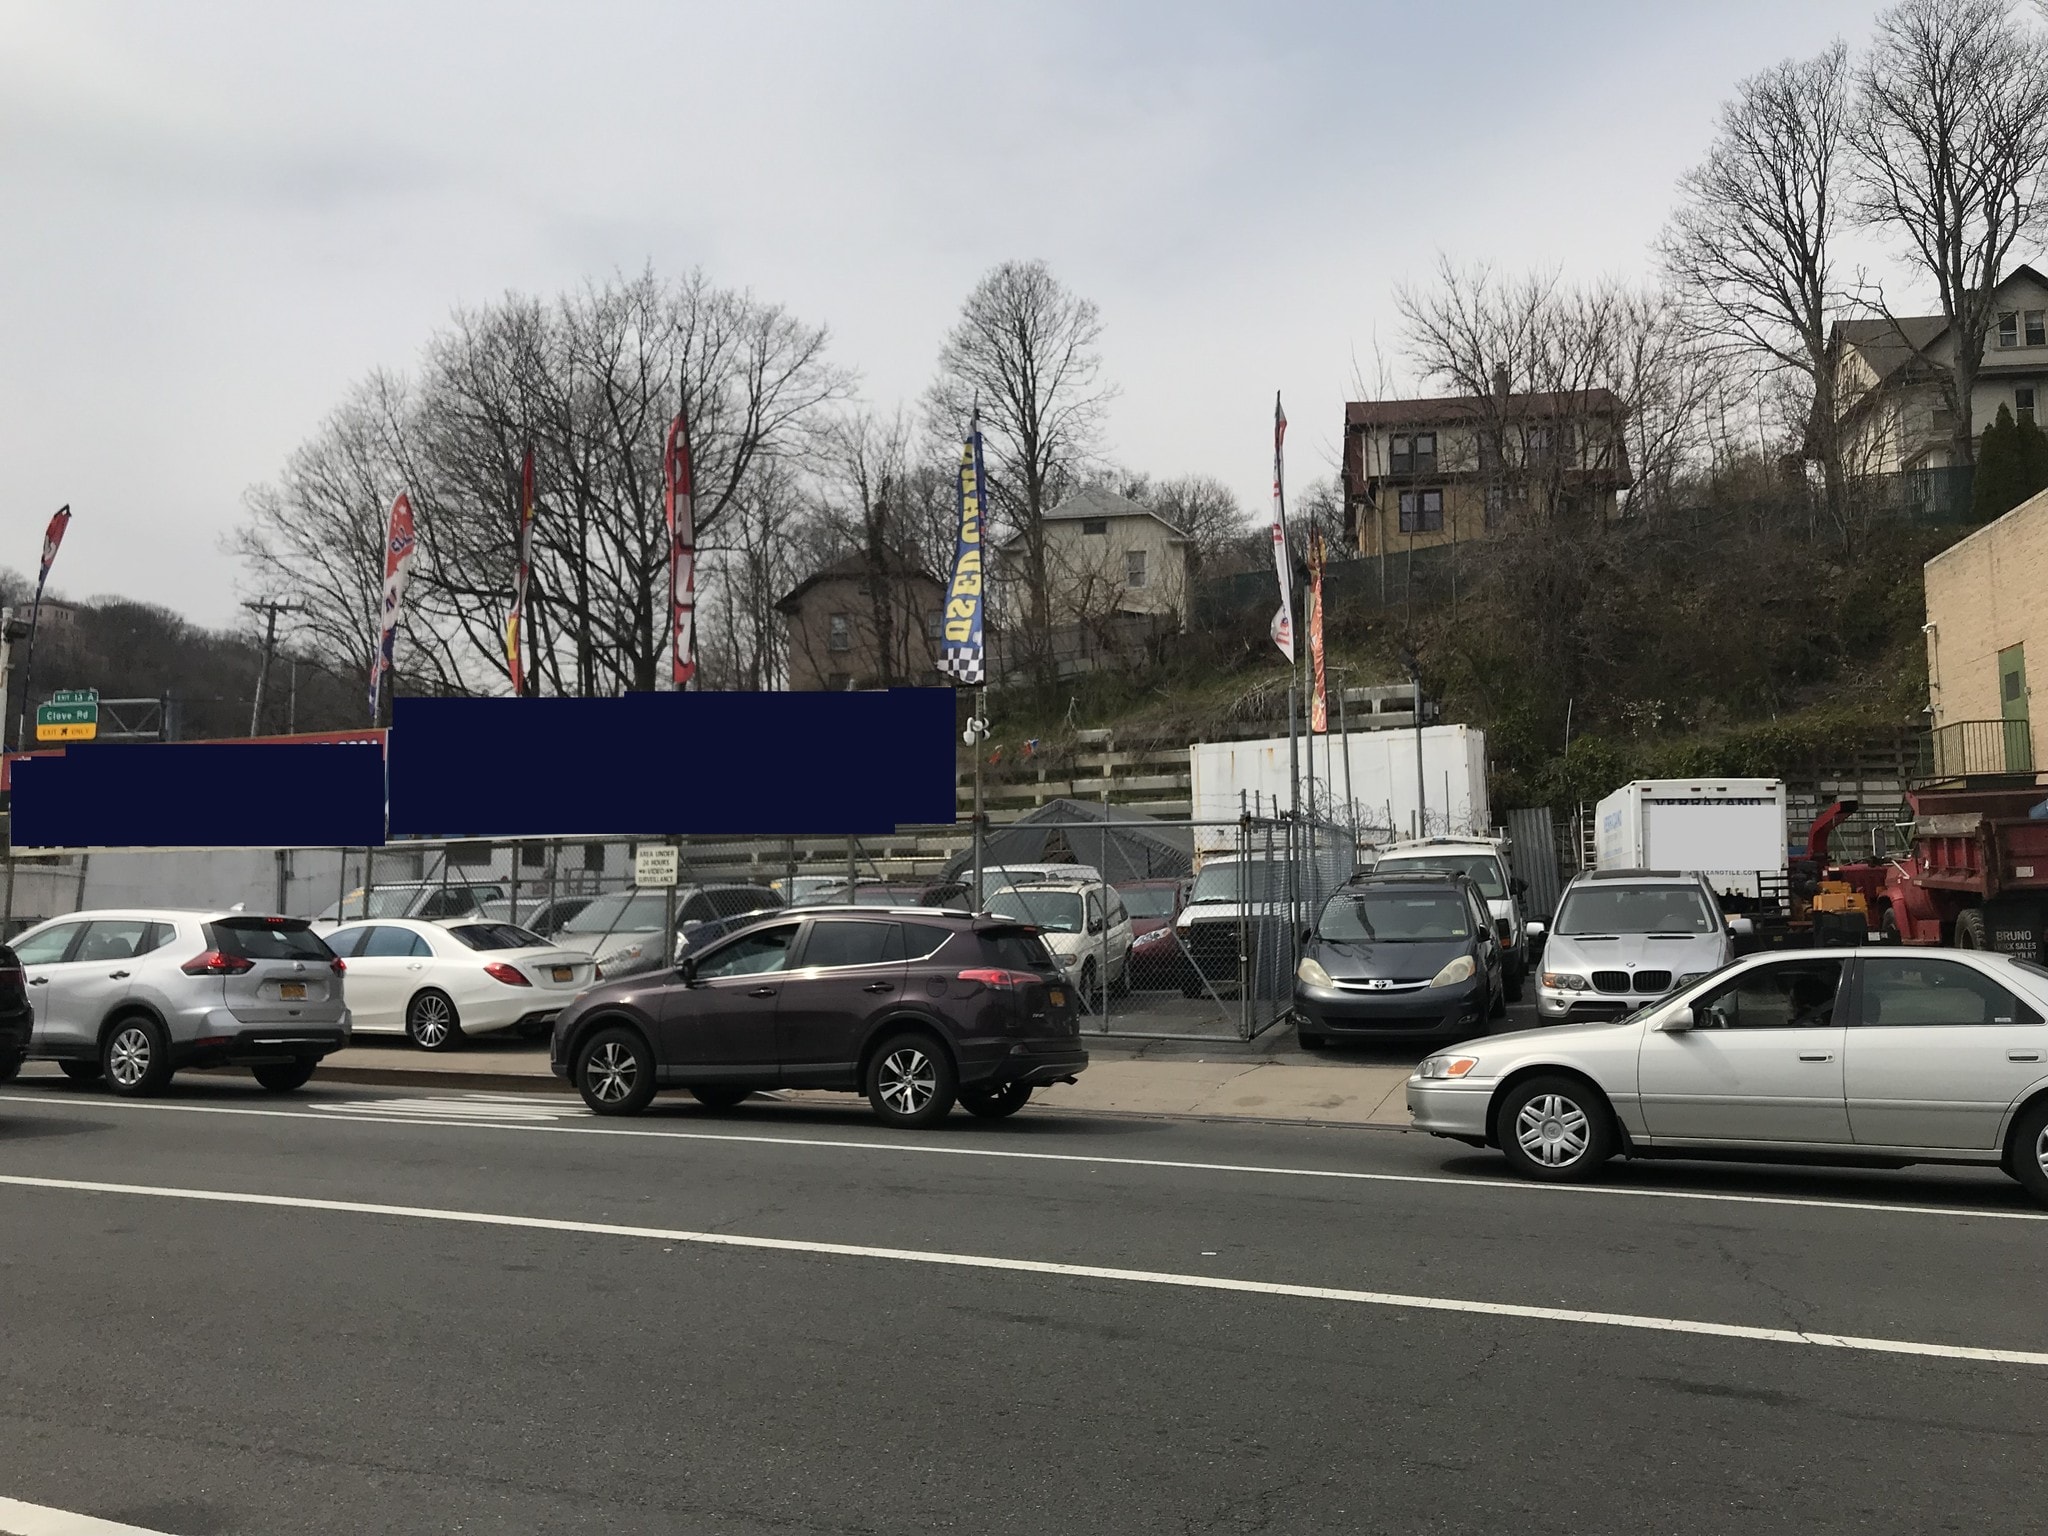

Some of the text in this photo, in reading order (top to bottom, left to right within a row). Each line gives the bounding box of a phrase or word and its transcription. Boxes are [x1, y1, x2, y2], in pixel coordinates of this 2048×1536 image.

[88, 692, 94, 701] A
[46, 709, 88, 720] Clove Rd
[1996, 930, 2032, 941] BRUNO
[2015, 942, 2037, 950] SALES
